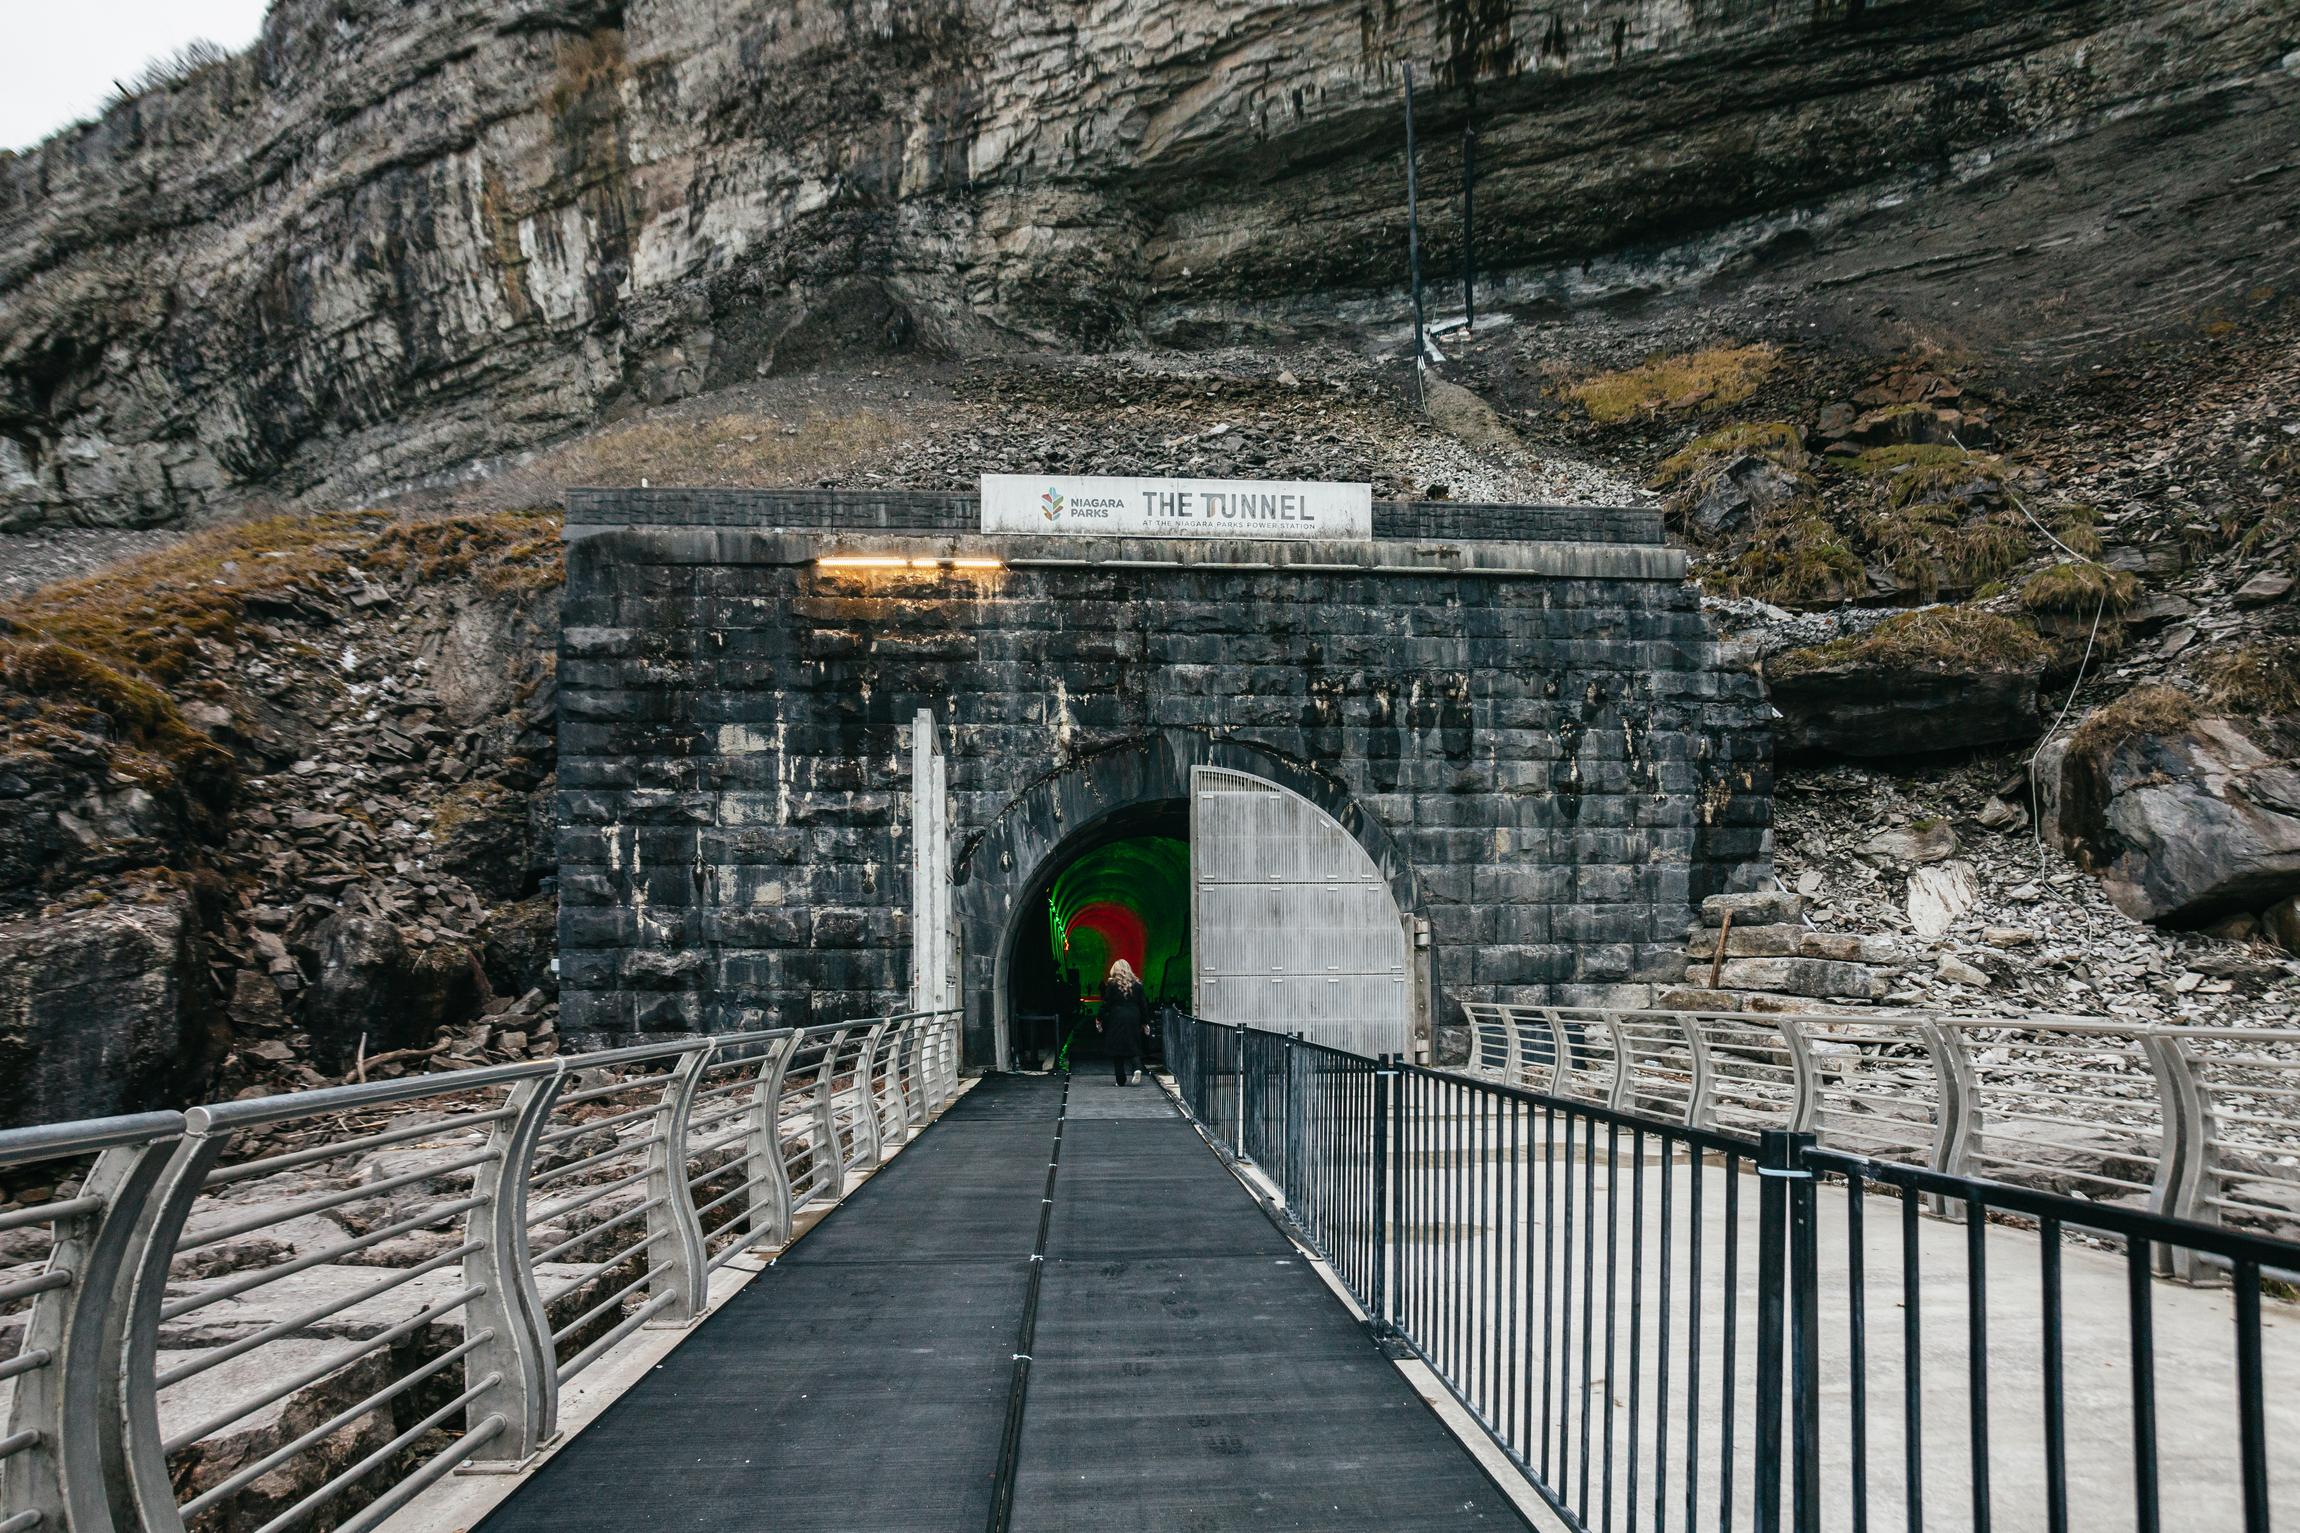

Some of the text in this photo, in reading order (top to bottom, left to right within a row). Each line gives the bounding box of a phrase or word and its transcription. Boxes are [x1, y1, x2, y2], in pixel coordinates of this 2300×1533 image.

[1071, 498, 1125, 508] NIAGARA
[1142, 491, 1315, 520] THE TUNNEL
[1071, 509, 1109, 518] PARKS
